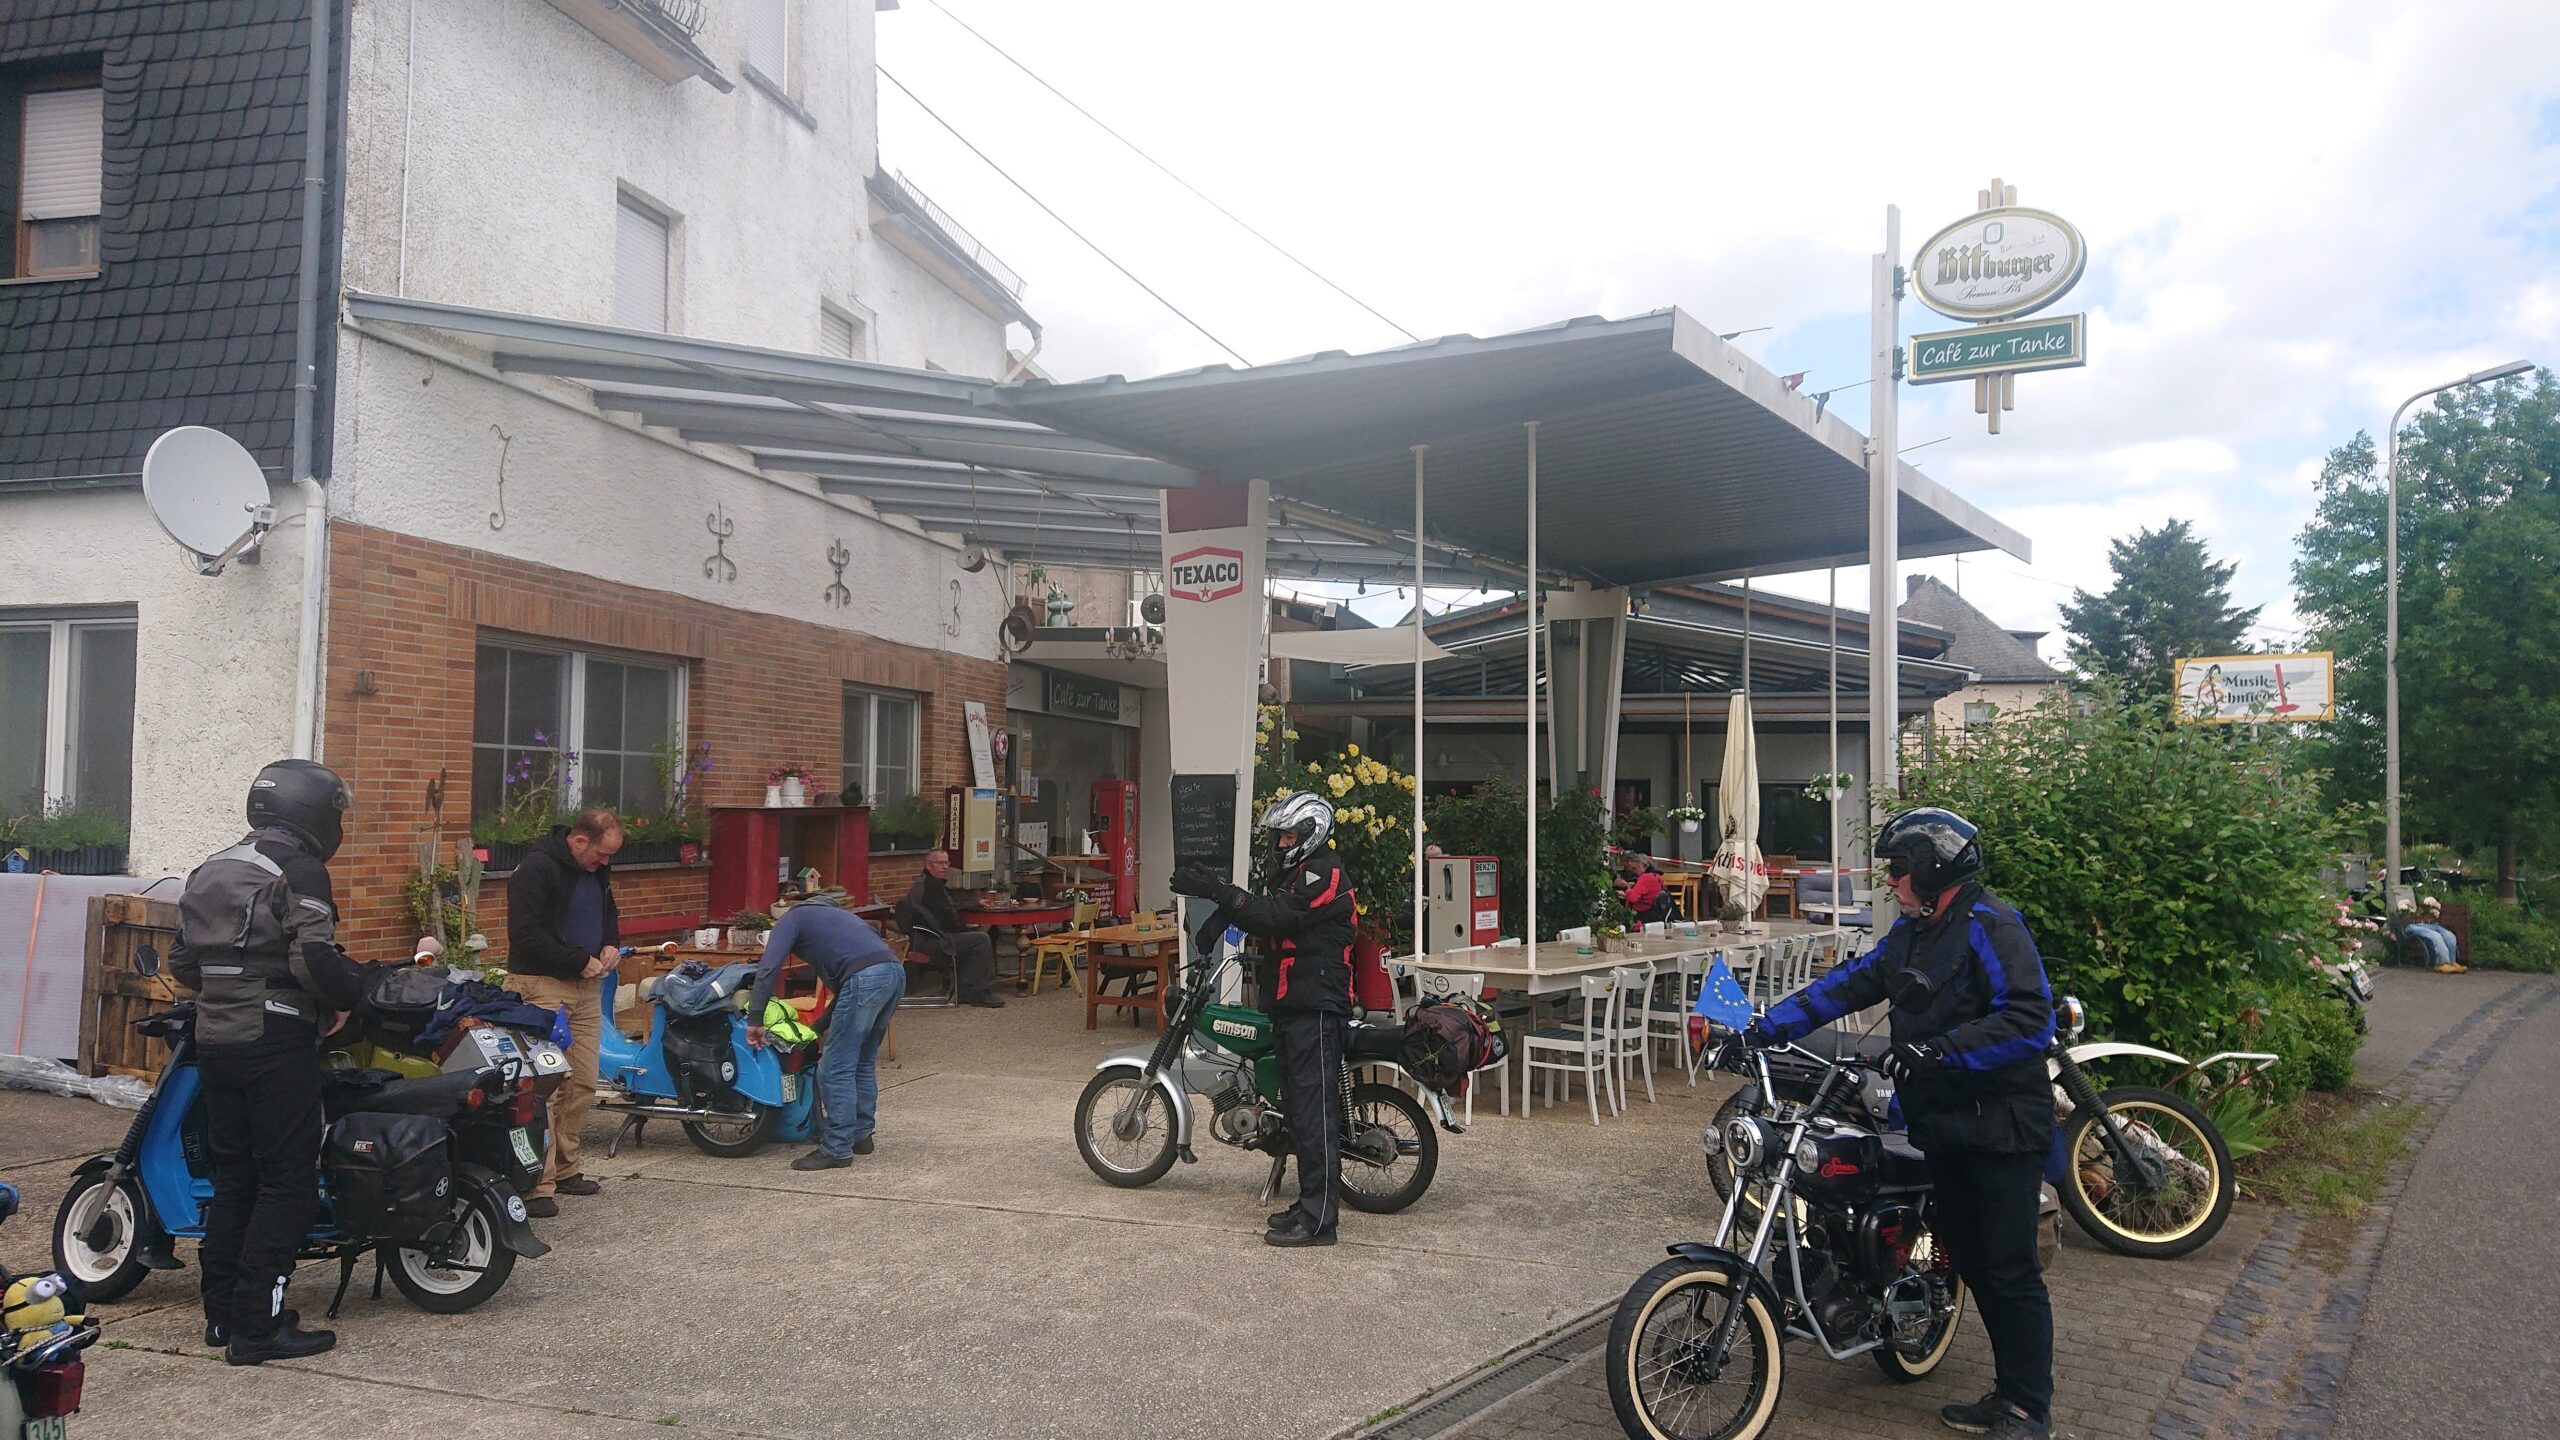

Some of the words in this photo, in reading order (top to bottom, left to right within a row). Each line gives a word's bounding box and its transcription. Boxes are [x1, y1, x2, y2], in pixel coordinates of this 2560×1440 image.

[1934, 242, 2055, 286] Bitburger
[1922, 342, 1962, 366] Café
[1968, 343, 2001, 361] zur
[2007, 331, 2066, 355] Tanke
[1173, 562, 1239, 585] TEXACO
[1053, 682, 1074, 707] Café
[1075, 692, 1092, 708] zur
[1093, 692, 1118, 713] Tanke
[1475, 862, 1496, 873] BENZIN
[1213, 1020, 1258, 1041] simson
[542, 1053, 556, 1066] D
